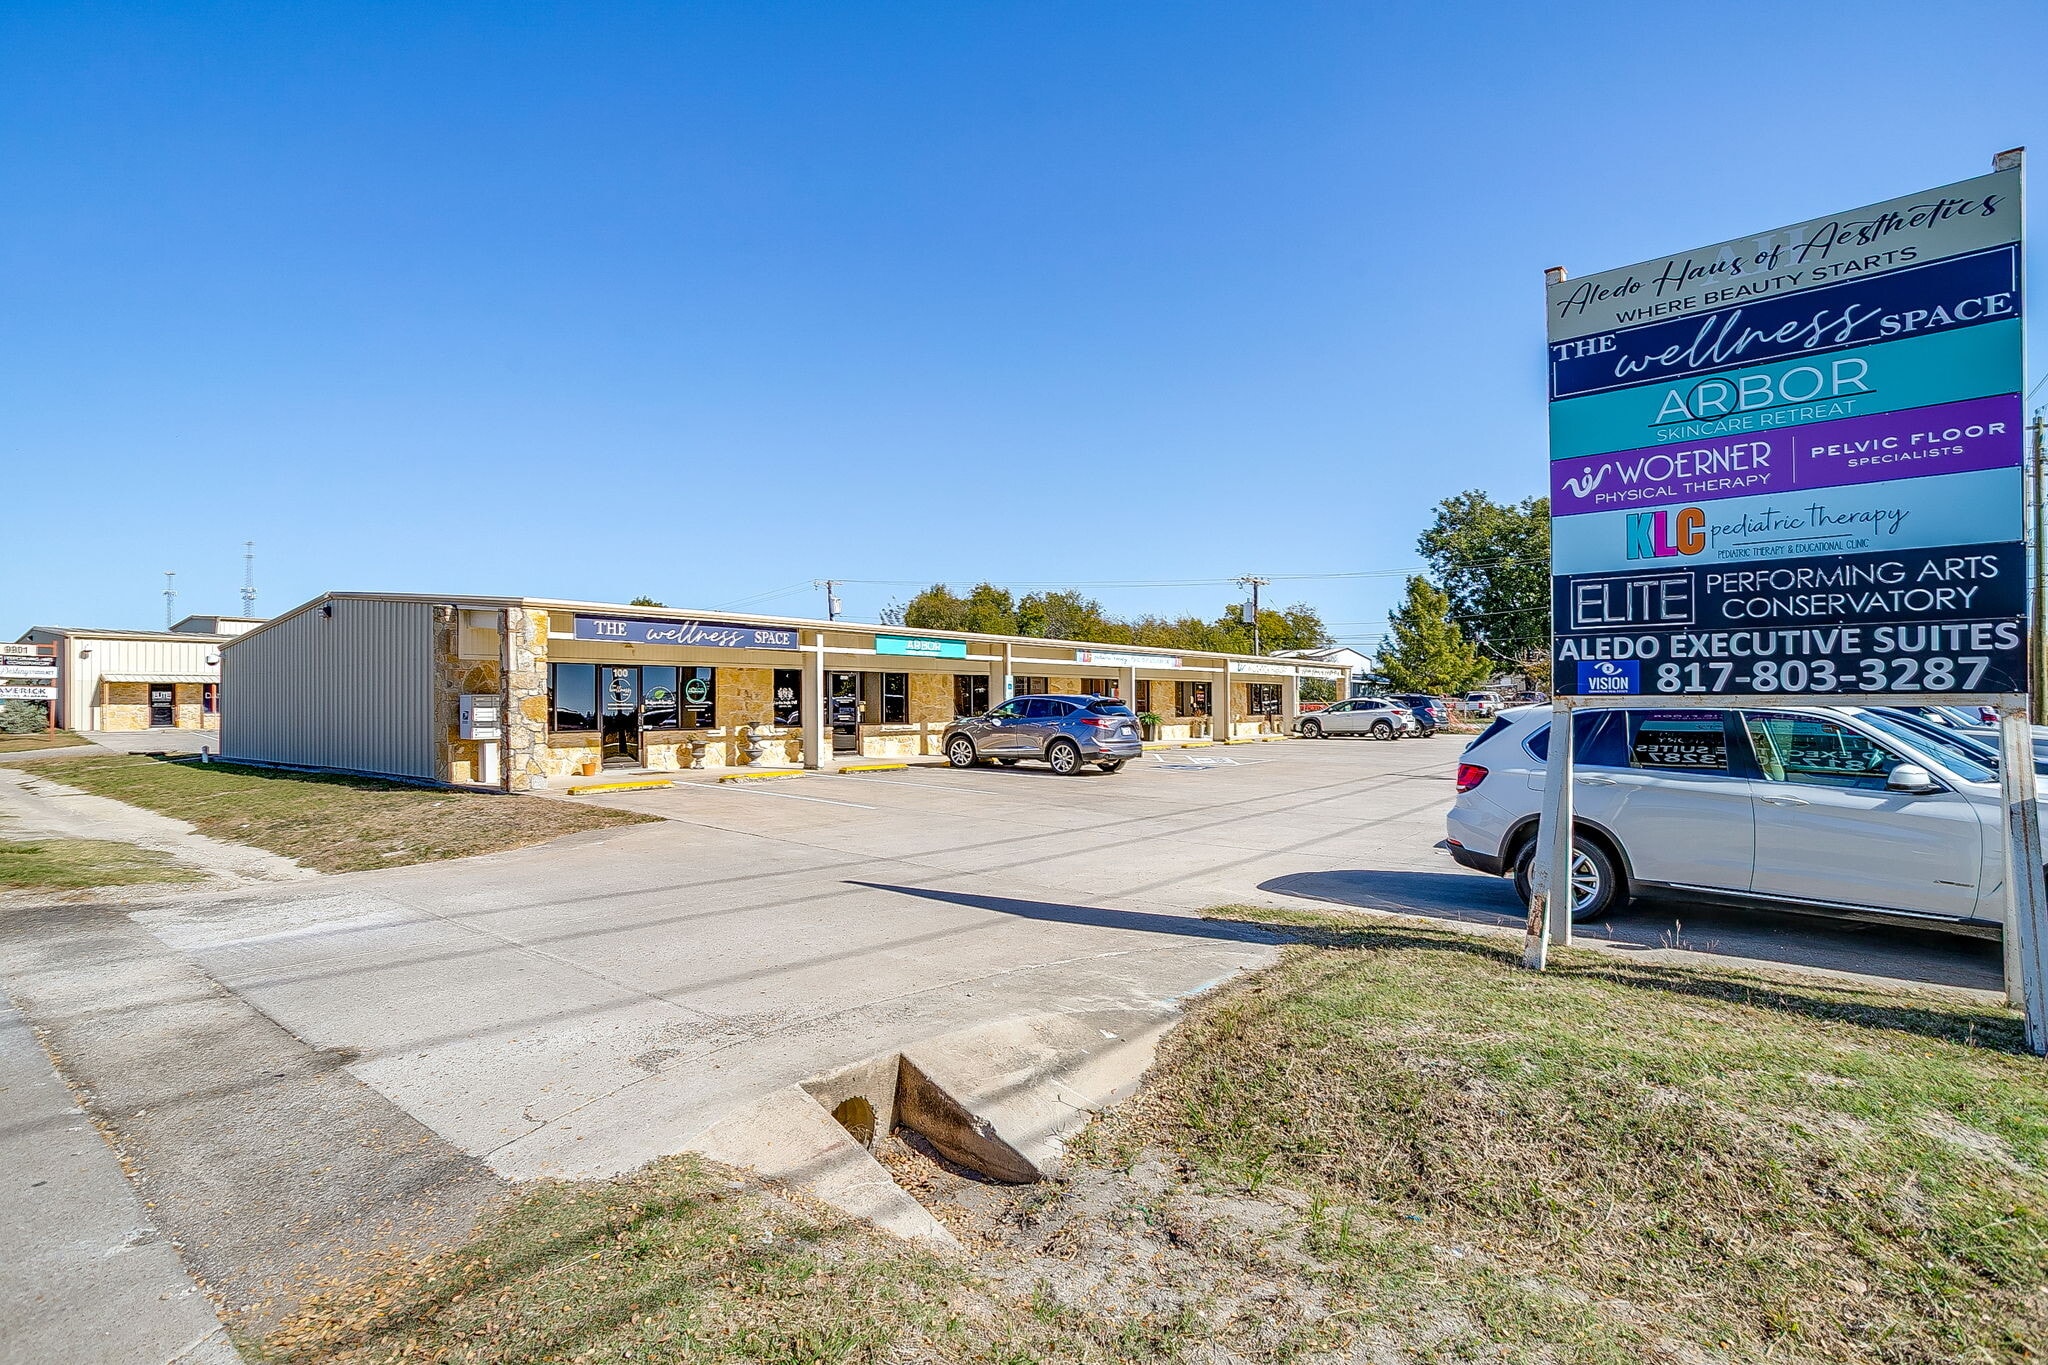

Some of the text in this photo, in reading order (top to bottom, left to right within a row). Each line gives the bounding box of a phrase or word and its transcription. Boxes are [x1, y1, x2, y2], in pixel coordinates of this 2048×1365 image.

[1557, 195, 2006, 318] Aledo Haus of Aesthetics
[1616, 247, 1918, 323] WHERE BEAUTY STARTS
[1553, 293, 2013, 378] THE wellness SPACE
[1655, 358, 1870, 424] ARBOR
[1657, 400, 1857, 442] SKINCARE RETREAT
[1811, 422, 2006, 458] PELVIC FLOOR
[1616, 441, 1772, 485] WOERNER
[1848, 445, 1964, 467] SPECIALISTS
[1595, 473, 1772, 504] PHYSICAL THERAPY
[1626, 507, 1706, 560] KLC
[1711, 502, 1910, 549] pediatric therapy
[1718, 538, 1870, 559] PEDIATRIC THERAPY & EDUCATIONAL CLINIC
[1706, 555, 1999, 594] PERFORMING ARTS
[1577, 579, 1688, 624] ELITE
[1722, 586, 1978, 619] CONSERVATORY
[593, 620, 790, 647] THE wellness SPACE
[1558, 622, 2019, 661] ALEDO EXECUTIVE SUITES
[0, 687, 46, 695] AVERICK
[613, 668, 629, 678] 100
[1588, 677, 1629, 690] VISION
[1656, 656, 1990, 692] 817-803-3287
